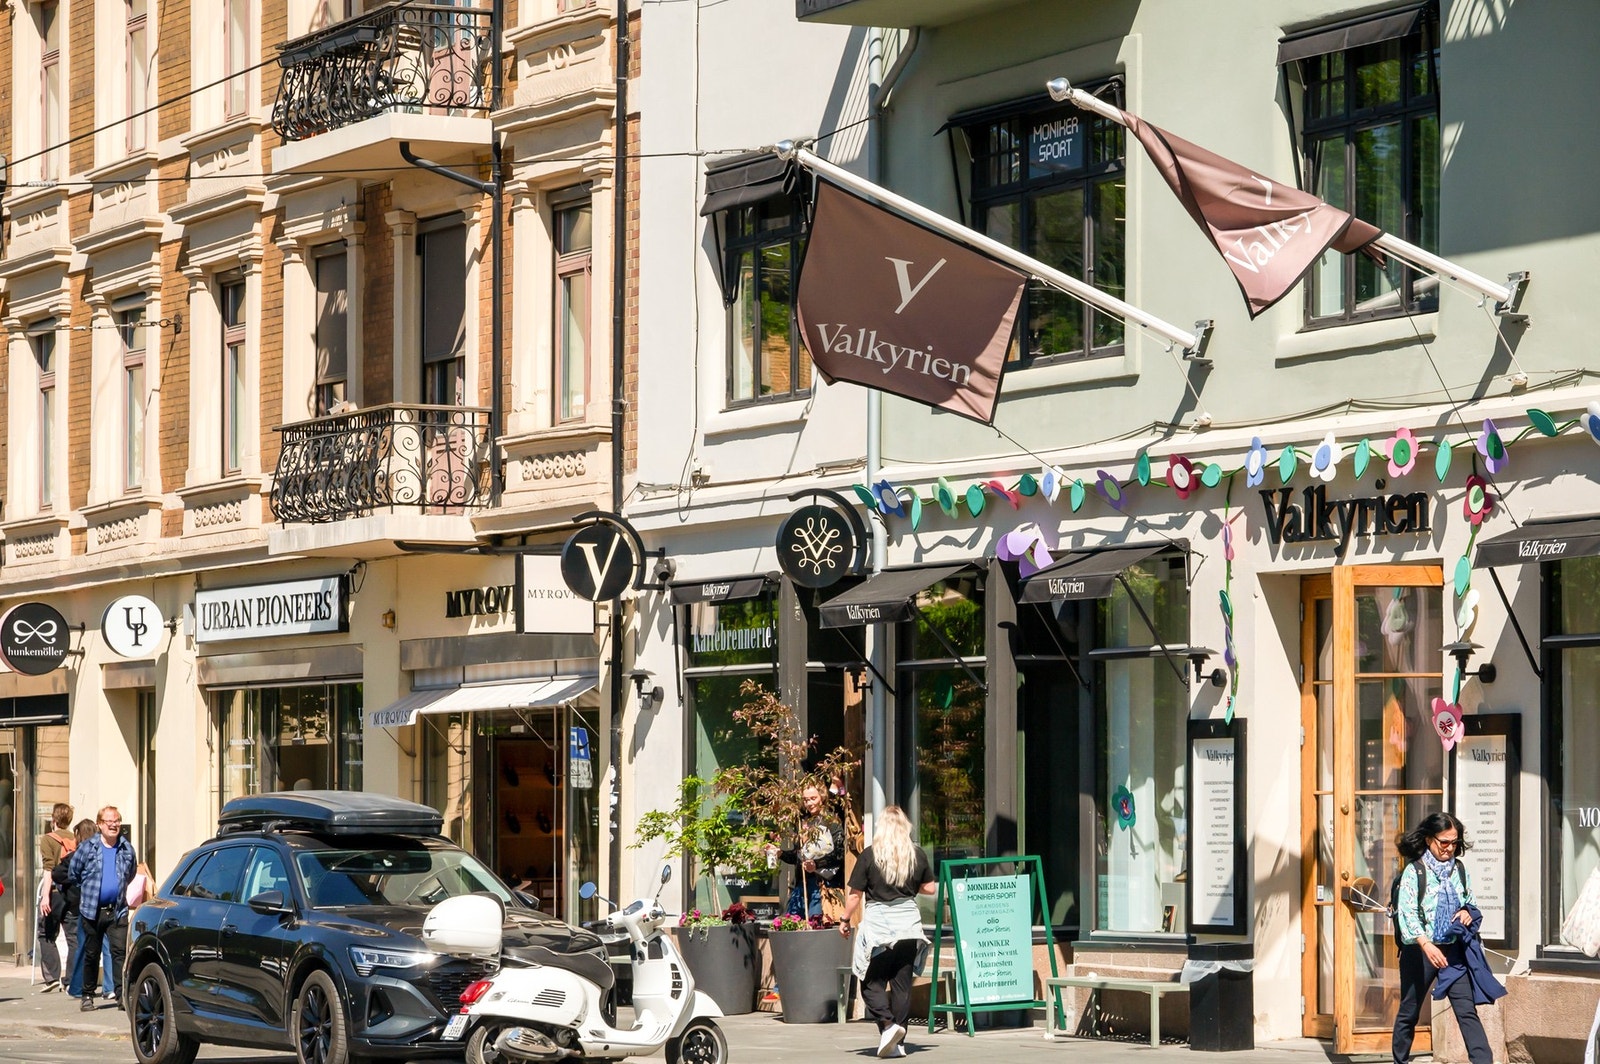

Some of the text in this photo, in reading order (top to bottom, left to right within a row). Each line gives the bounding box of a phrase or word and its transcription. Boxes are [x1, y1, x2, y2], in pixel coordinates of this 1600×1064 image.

[1033, 116, 1079, 144] MONIKER
[1039, 138, 1073, 163] SPORT
[815, 323, 971, 388] Valkyrien
[1258, 478, 1433, 558] Valkyrien
[1518, 539, 1567, 557] Valkyrien
[702, 582, 730, 600] Valkyrien
[1048, 578, 1085, 598] Valkyrien
[202, 590, 333, 631] URBAN PIONEERS
[846, 604, 880, 622] Valkyrien
[7, 646, 64, 657] hunkemöller
[967, 881, 1017, 892] MONIKER MAN
[996, 891, 1017, 900] SPORT
[978, 940, 1010, 948] MONIKER
[976, 960, 1013, 969] Maanesten
[972, 979, 1018, 989] Kaffebrenneriet
